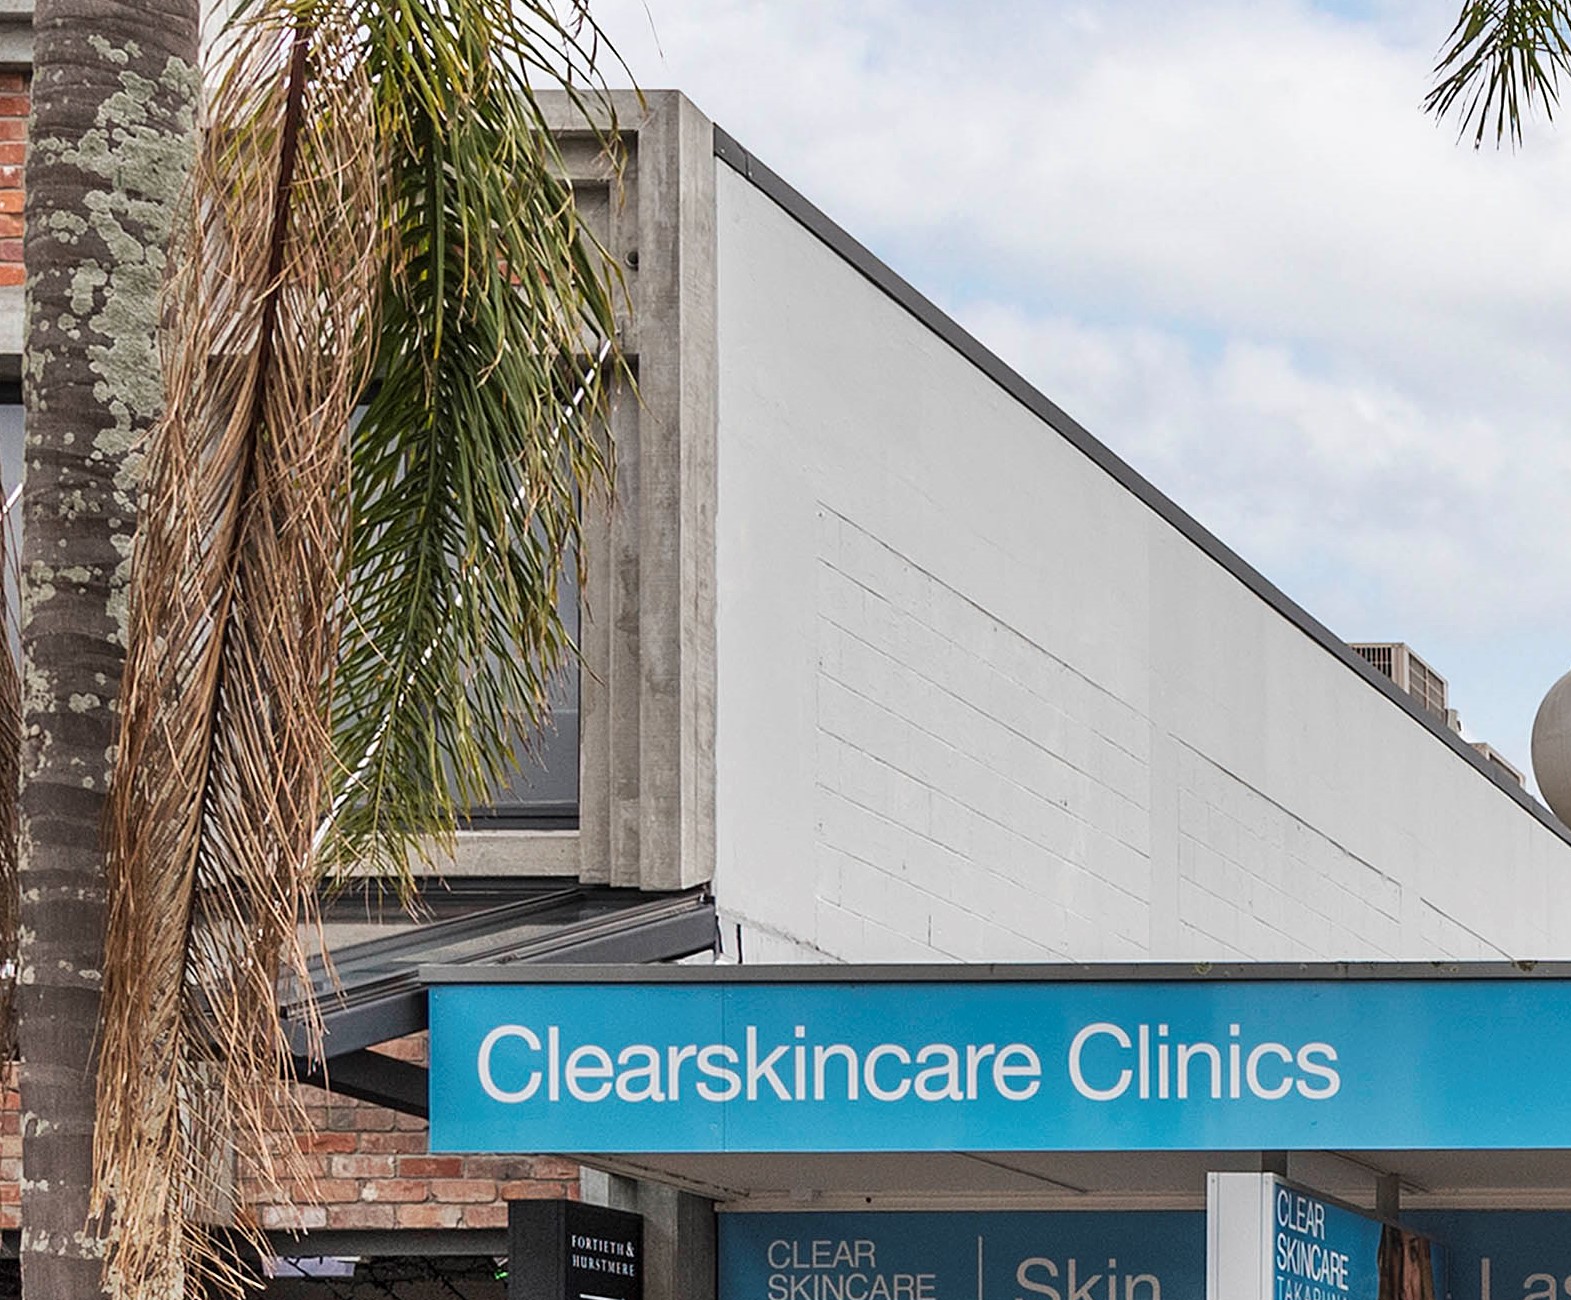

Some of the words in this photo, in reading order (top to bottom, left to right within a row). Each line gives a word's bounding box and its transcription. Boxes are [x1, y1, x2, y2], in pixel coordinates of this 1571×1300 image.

[477, 1024, 1042, 1105] Clearskincare
[1068, 1021, 1341, 1104] Clinics
[1277, 1189, 1325, 1240] CLEAR
[571, 1234, 624, 1256] FORTIETH
[572, 1254, 635, 1277] HURSTMERE
[766, 1239, 876, 1271] CLEAR
[1276, 1232, 1350, 1291] SKINCARE
